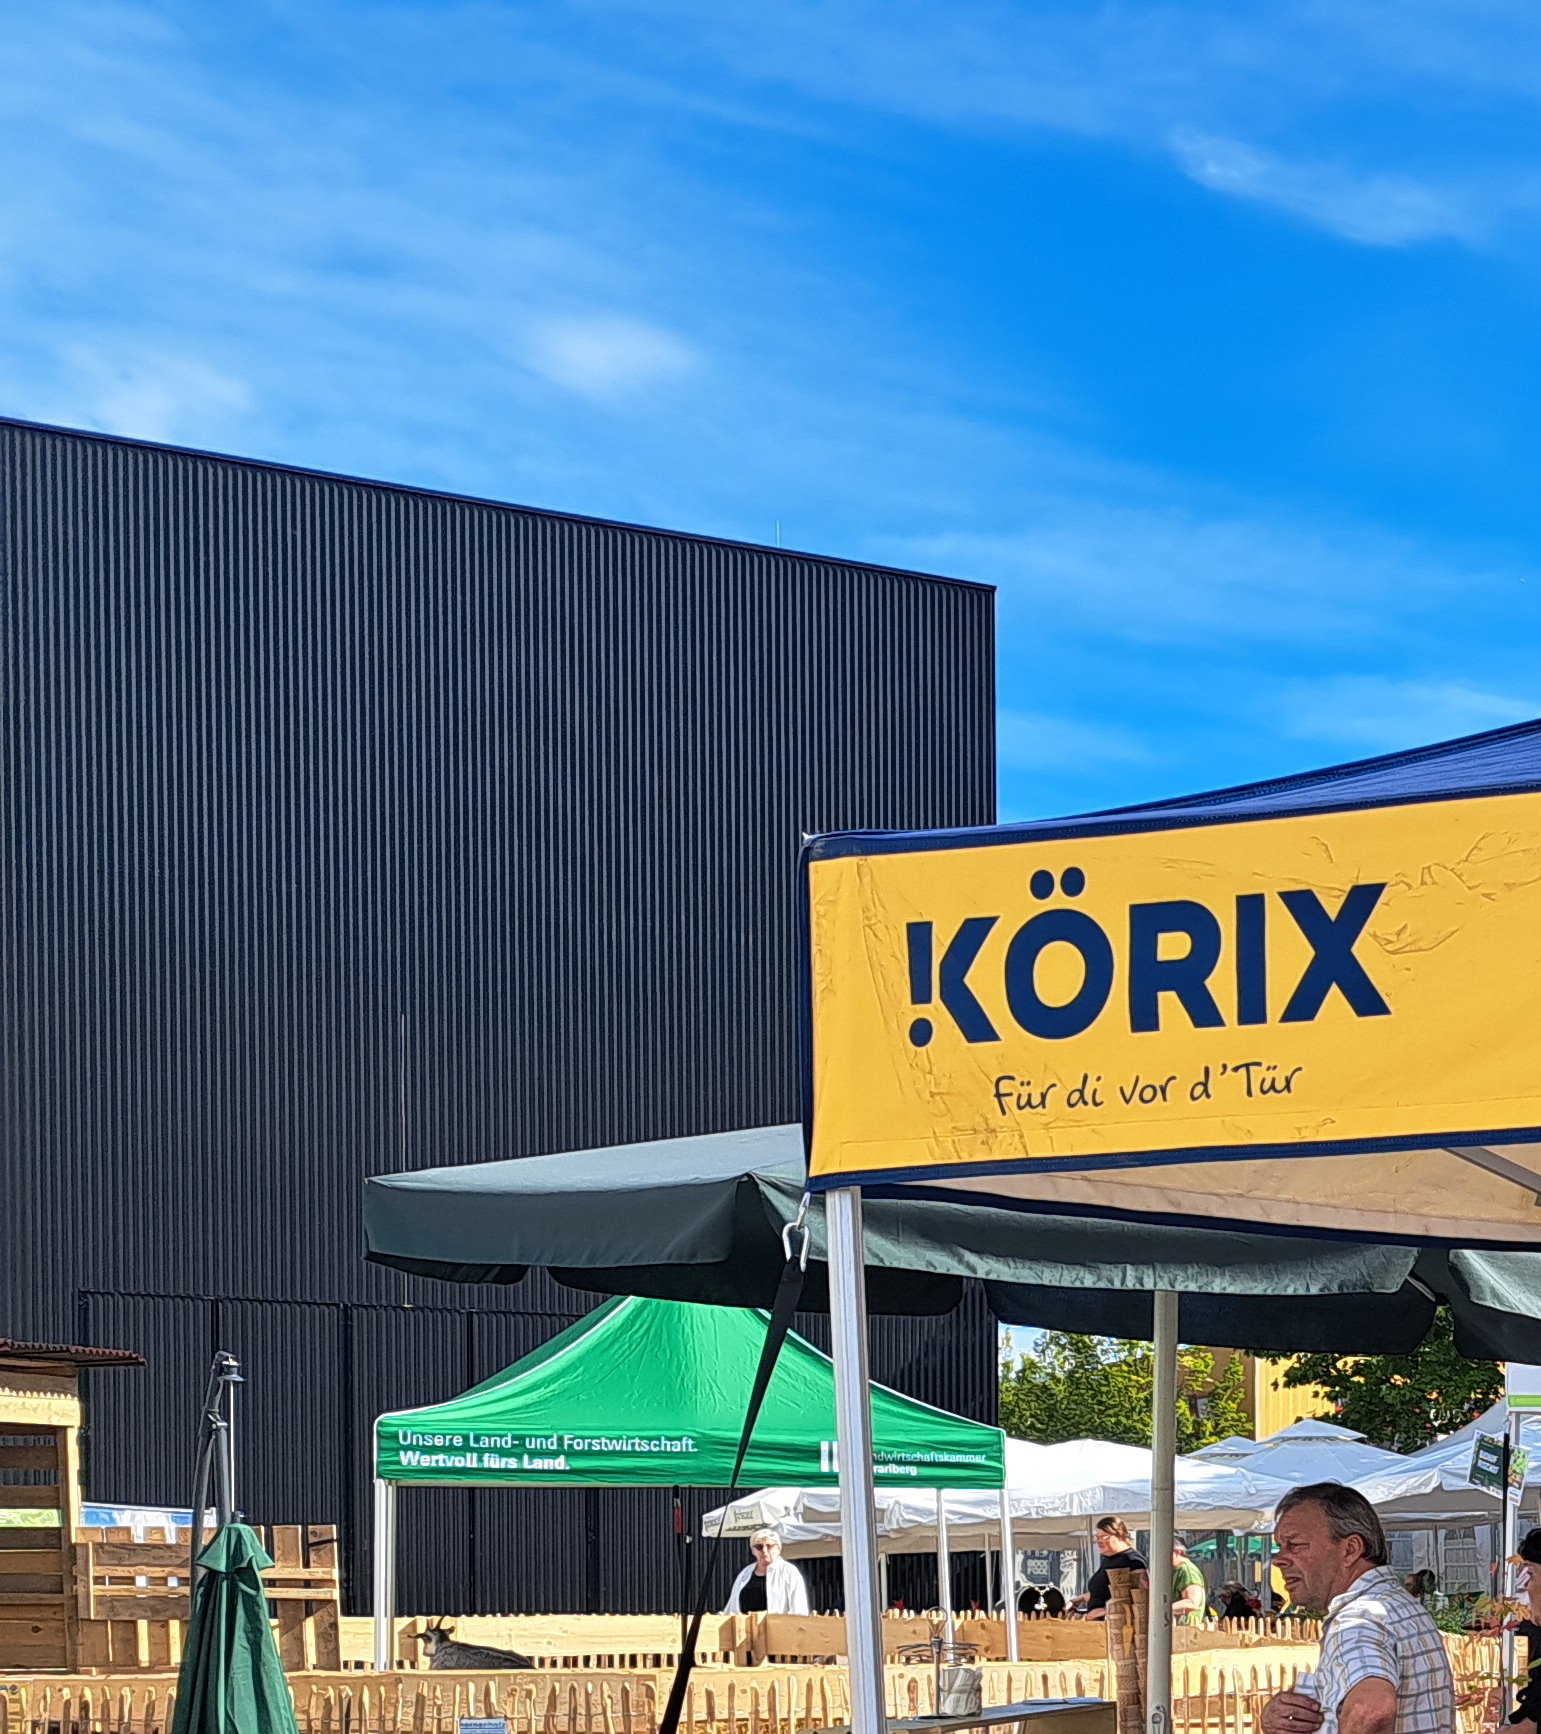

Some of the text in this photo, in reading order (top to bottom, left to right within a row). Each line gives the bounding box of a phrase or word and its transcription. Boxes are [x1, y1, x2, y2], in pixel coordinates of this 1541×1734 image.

[994, 1072, 1058, 1116] Für
[1066, 1073, 1104, 1109] di
[1119, 1075, 1179, 1106] vor
[398, 1429, 699, 1453] Unsere Land- und Forstwirtschaft.
[400, 1450, 571, 1471] Wertvoll fürs Land.
[872, 1450, 987, 1464] ndwirtschaftskammer
[873, 1463, 918, 1476] rarlberg
